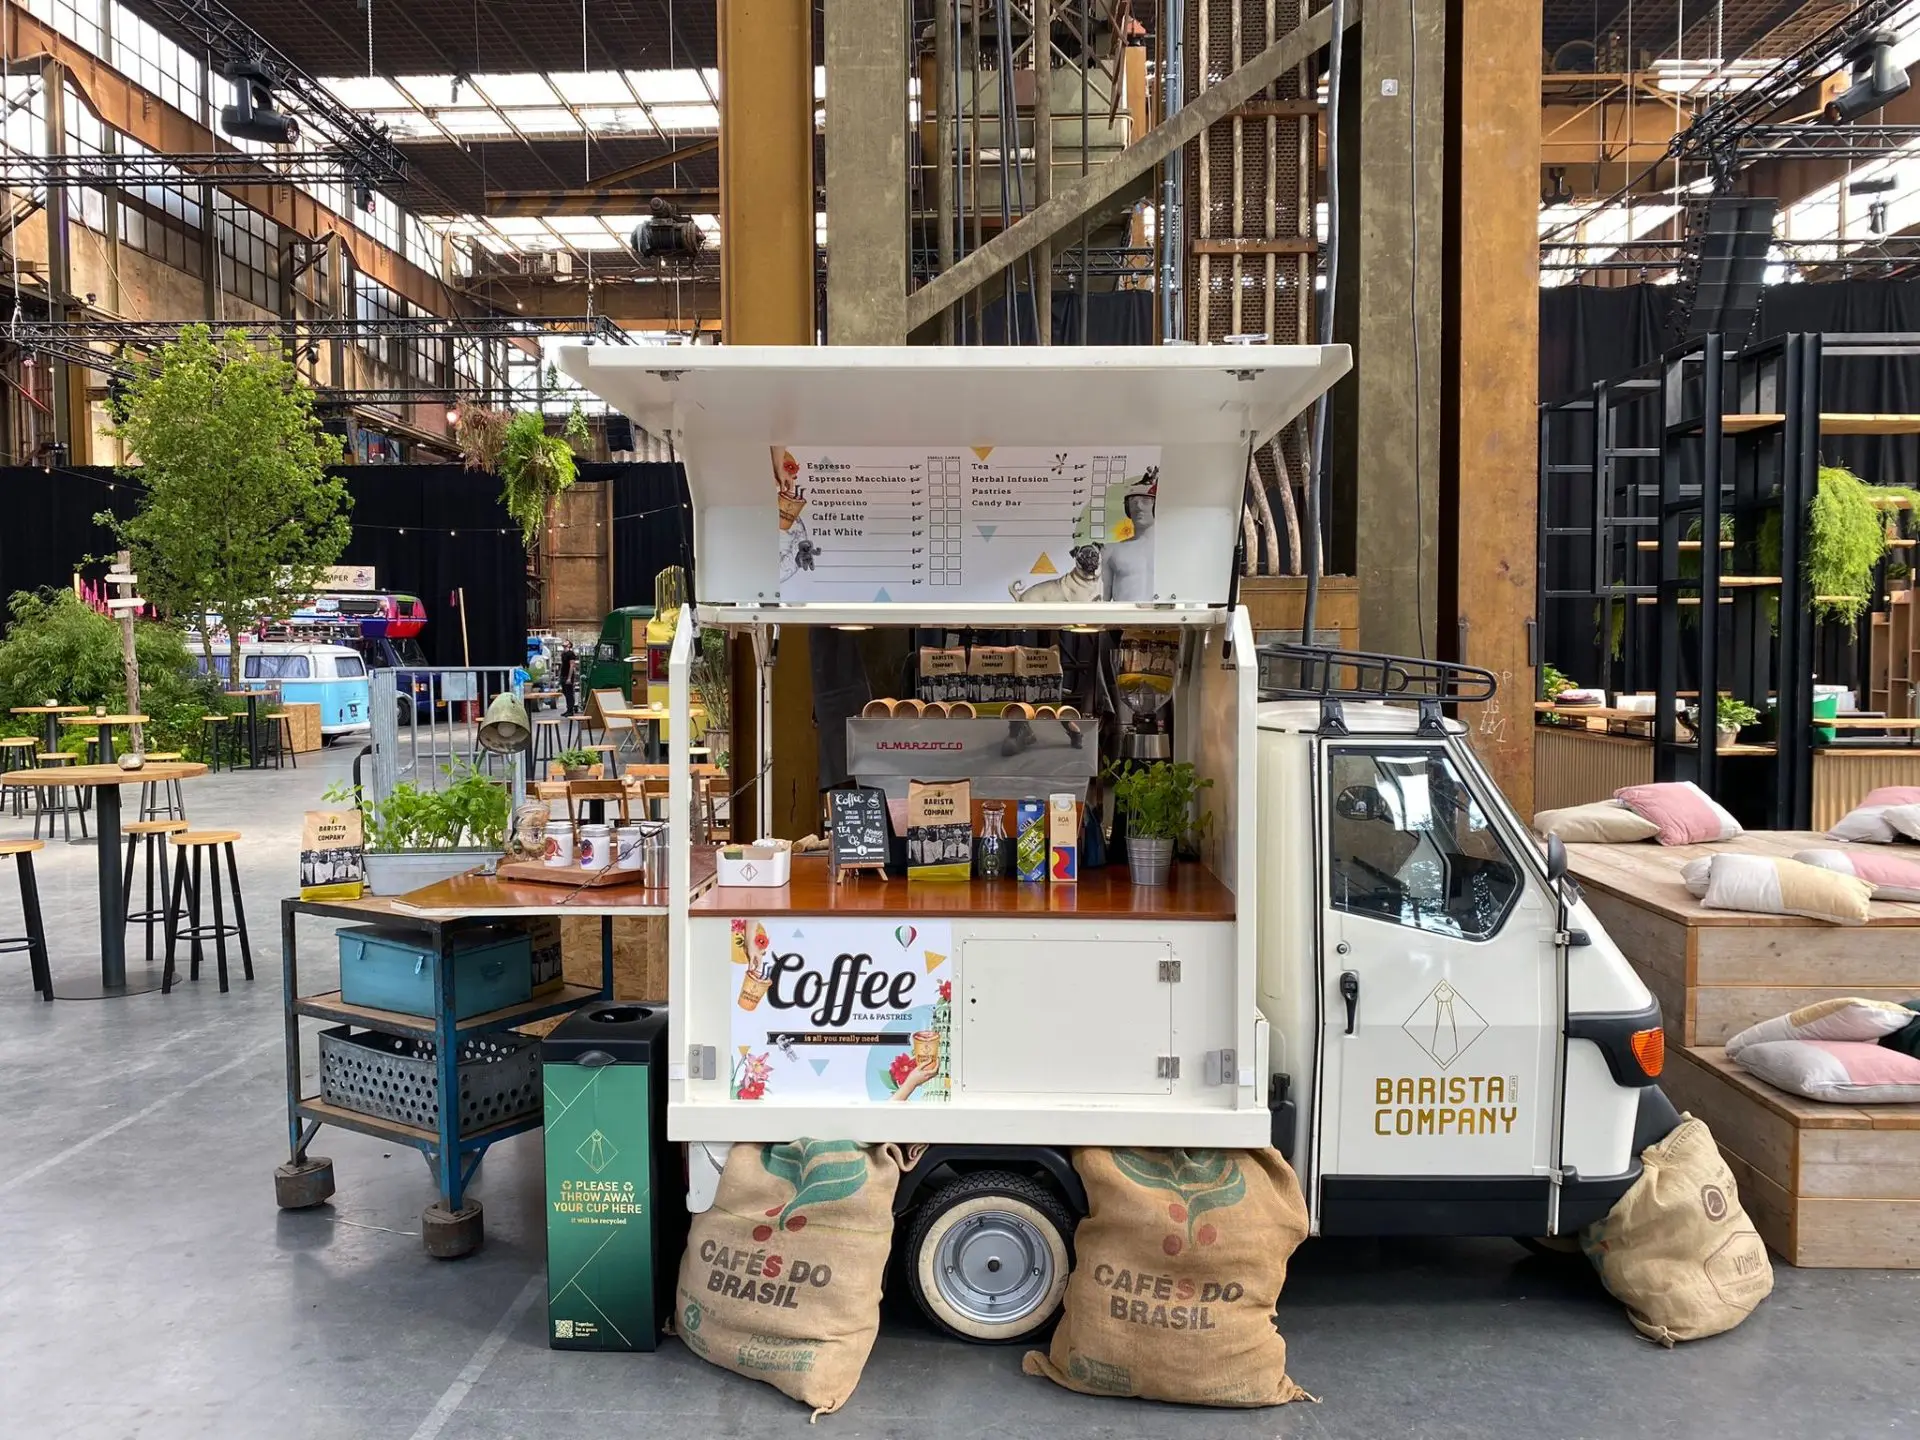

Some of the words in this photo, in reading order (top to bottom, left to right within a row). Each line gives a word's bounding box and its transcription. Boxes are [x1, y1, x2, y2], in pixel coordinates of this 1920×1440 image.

[807, 462, 851, 472] Espresso
[808, 475, 852, 483] Espresso
[855, 475, 907, 483] Macchiato
[971, 475, 1005, 483] Herbal
[1007, 475, 1049, 483] Infusion
[810, 487, 863, 495] Americano
[971, 487, 1012, 495] Pastries
[811, 499, 868, 508] Cappuccino
[971, 499, 1002, 508] Candy
[1005, 499, 1022, 507] Bar
[840, 513, 865, 521] Latte
[812, 528, 831, 536] Flat
[834, 528, 863, 536] White
[834, 793, 864, 807] Coffee
[837, 826, 850, 834] TEA
[766, 951, 916, 1027] Coffee
[804, 1034, 811, 1042] is
[812, 1034, 822, 1042] all
[838, 1034, 860, 1043] really
[861, 1034, 880, 1042] need
[1375, 1076, 1505, 1105] BARISTA
[1374, 1106, 1518, 1136] COMPANY
[575, 1181, 619, 1191] PLEASE
[560, 1191, 600, 1201] THROW
[603, 1192, 635, 1202] AWAY
[553, 1202, 583, 1212] YOUR
[586, 1203, 609, 1213] CUP
[611, 1204, 642, 1214] HERE
[700, 1239, 784, 1278] CAFÉS
[788, 1260, 832, 1288] DO
[1094, 1264, 1195, 1300] CAFÉS
[1200, 1281, 1244, 1303] DO
[706, 1270, 799, 1309] BRASIL
[1110, 1295, 1216, 1330] BRASIL
